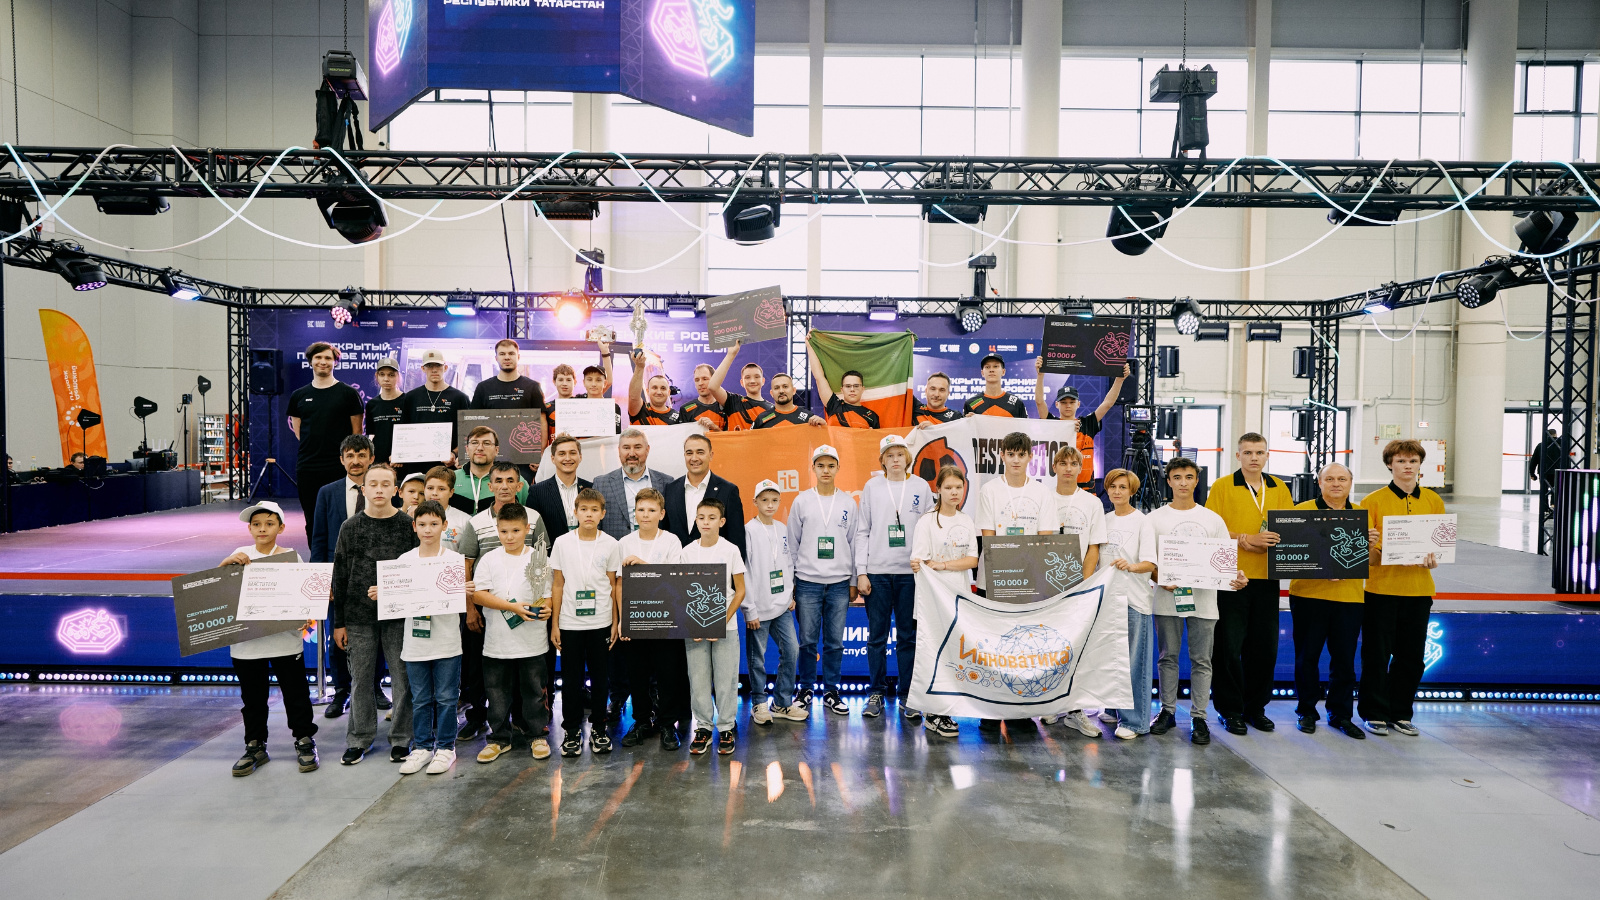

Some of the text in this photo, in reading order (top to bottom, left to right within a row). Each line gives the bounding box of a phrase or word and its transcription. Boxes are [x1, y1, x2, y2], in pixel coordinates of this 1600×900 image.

[533, 0, 605, 8] ТАТАРСТАН
[779, 472, 797, 489] it
[187, 622, 205, 633] 120
[206, 617, 225, 628] 000
[959, 633, 1071, 668] Инноватика
